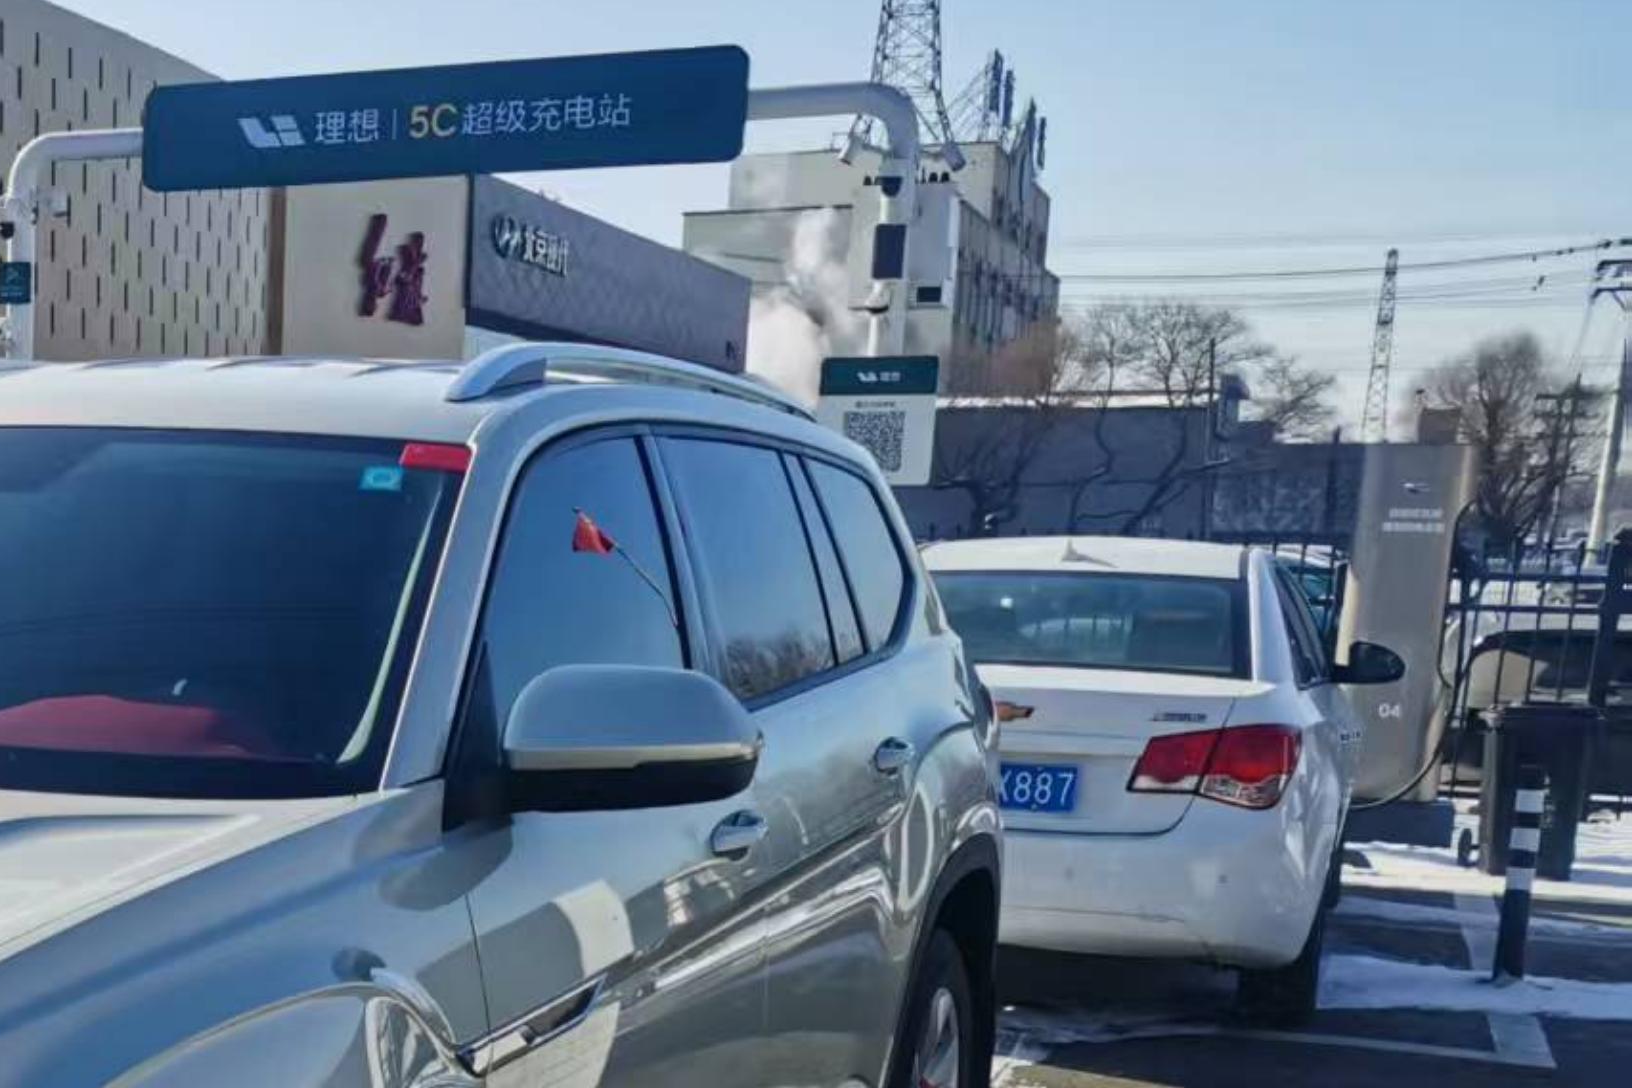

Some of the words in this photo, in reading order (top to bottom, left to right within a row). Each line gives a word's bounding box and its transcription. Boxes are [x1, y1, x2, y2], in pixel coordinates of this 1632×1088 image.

[314, 108, 379, 145] 理想
[408, 93, 632, 138] 5C超级充电站
[1378, 703, 1401, 718] 04
